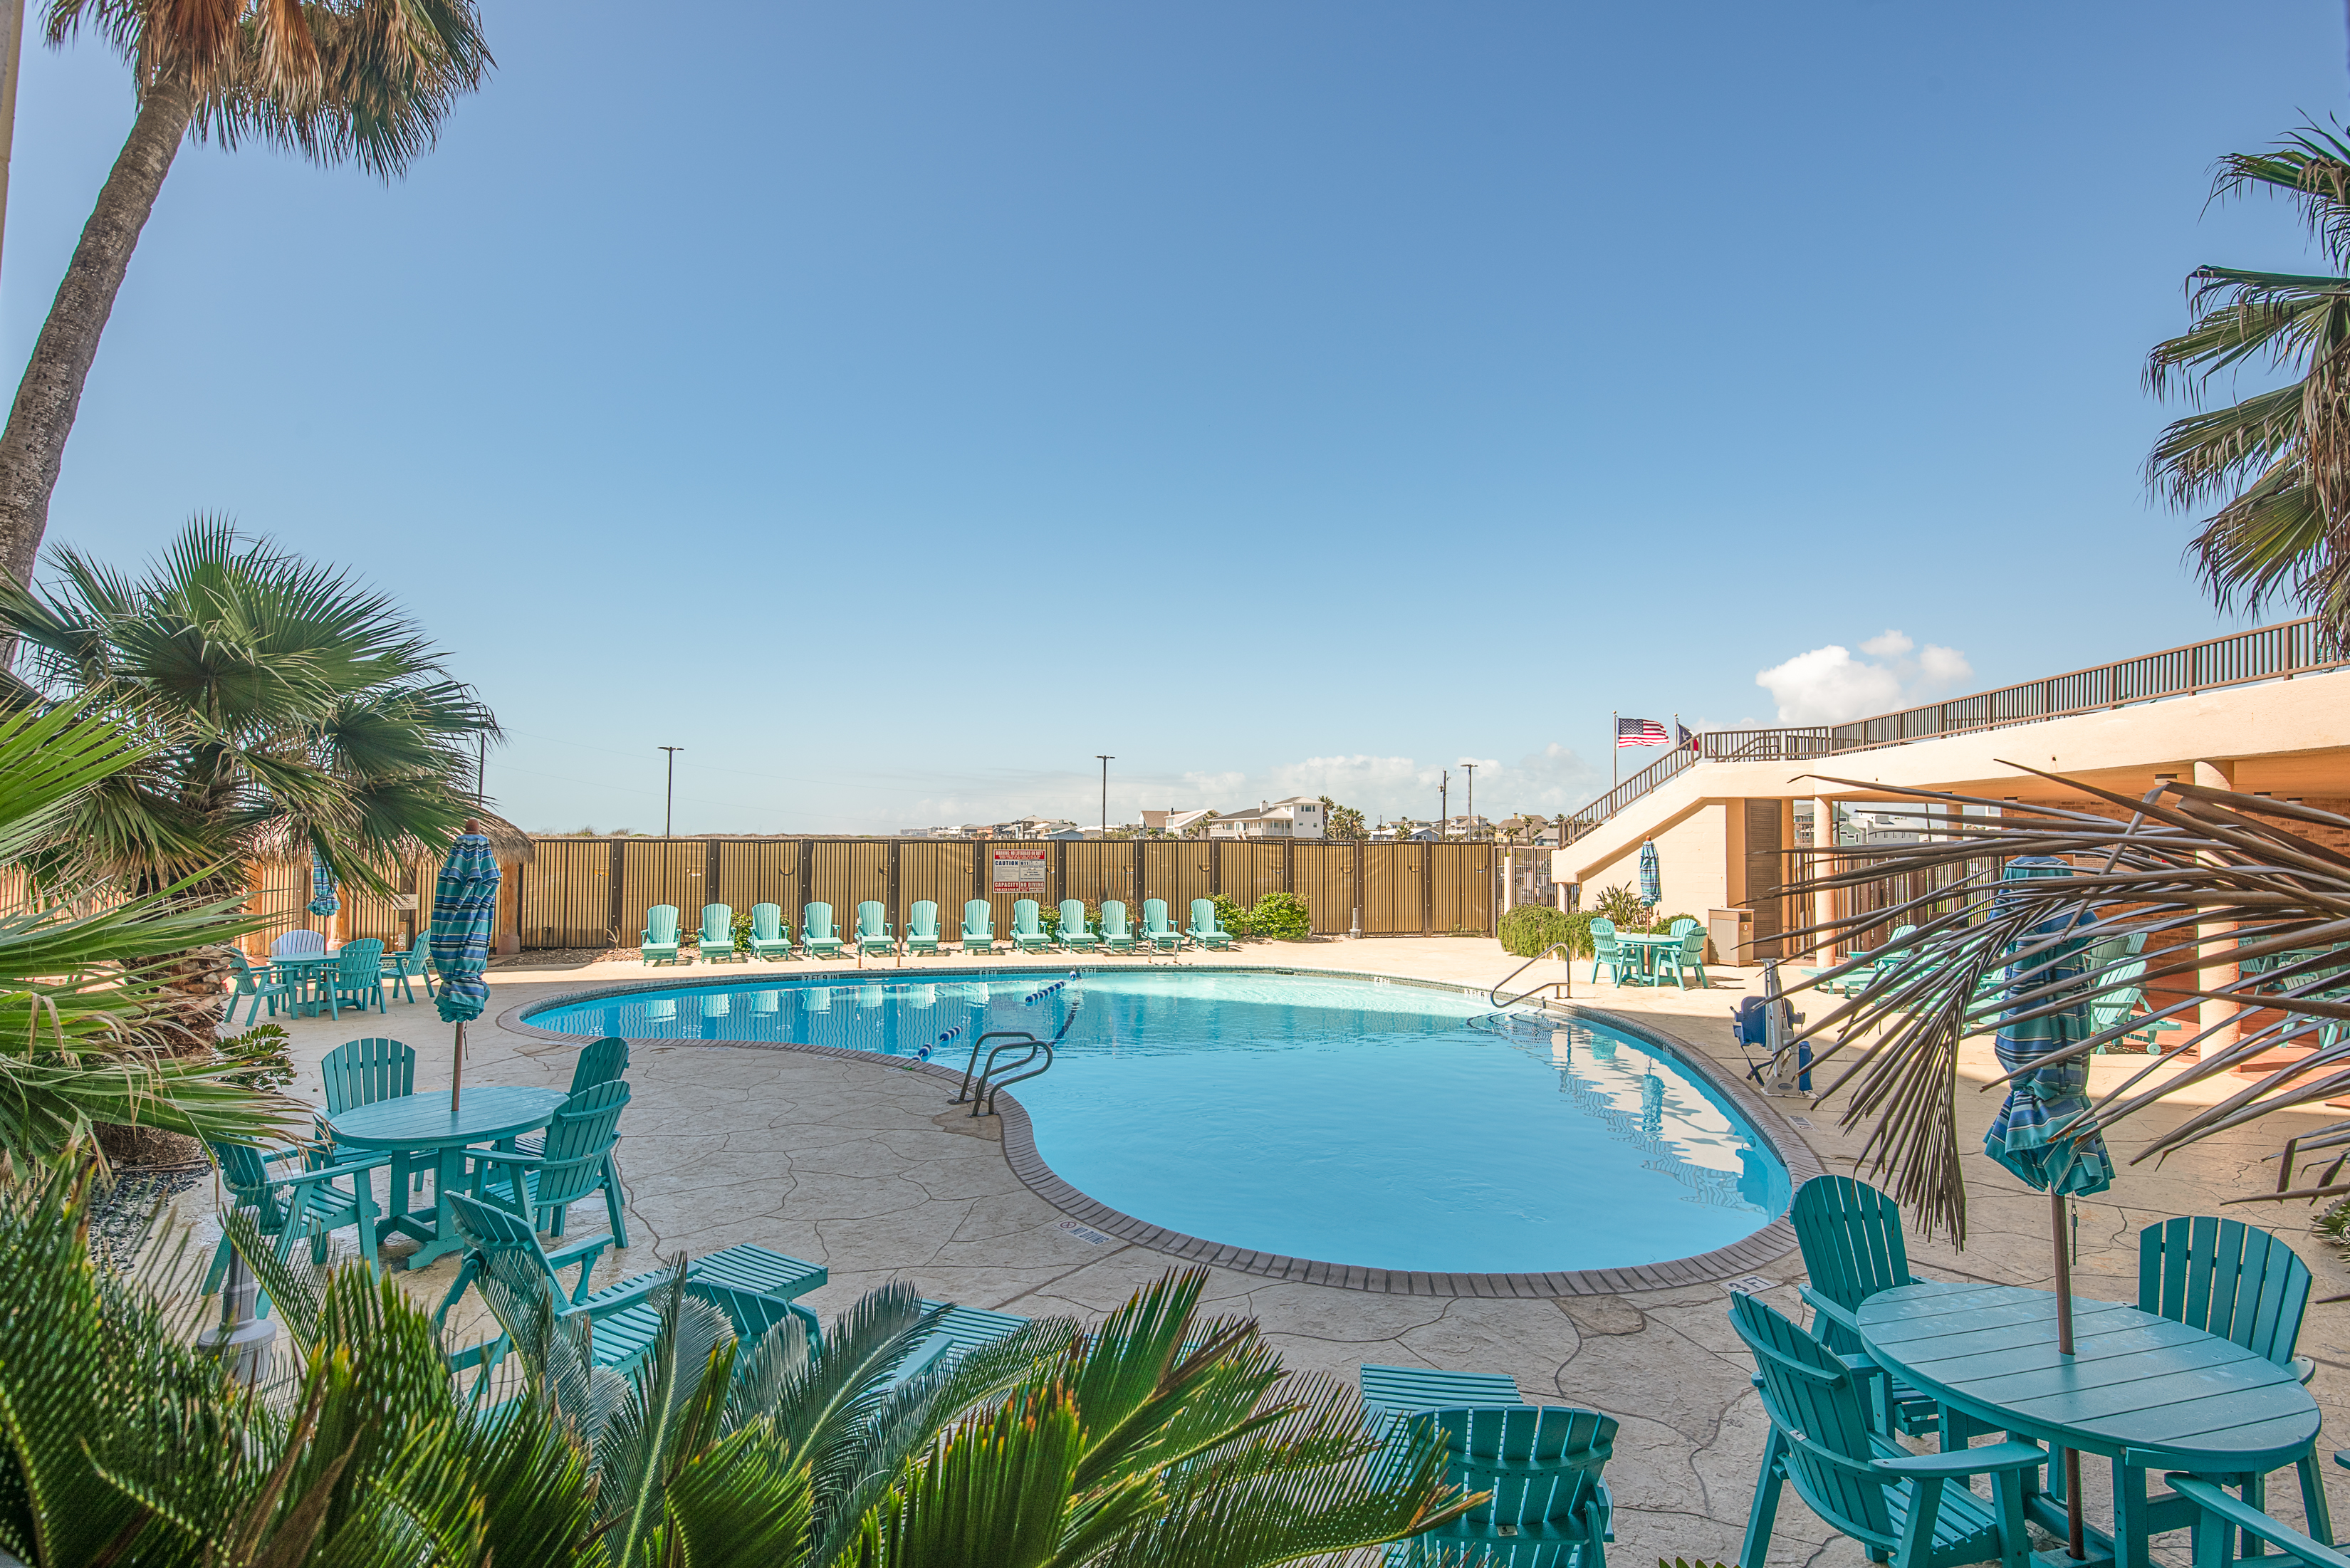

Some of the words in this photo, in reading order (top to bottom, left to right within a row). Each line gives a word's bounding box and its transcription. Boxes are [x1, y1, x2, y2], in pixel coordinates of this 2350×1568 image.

[1069, 1226, 1088, 1235] NO
[1079, 1230, 1109, 1245] DIVING
[1728, 1282, 1750, 1292] 3
[1742, 1276, 1771, 1289] FT
